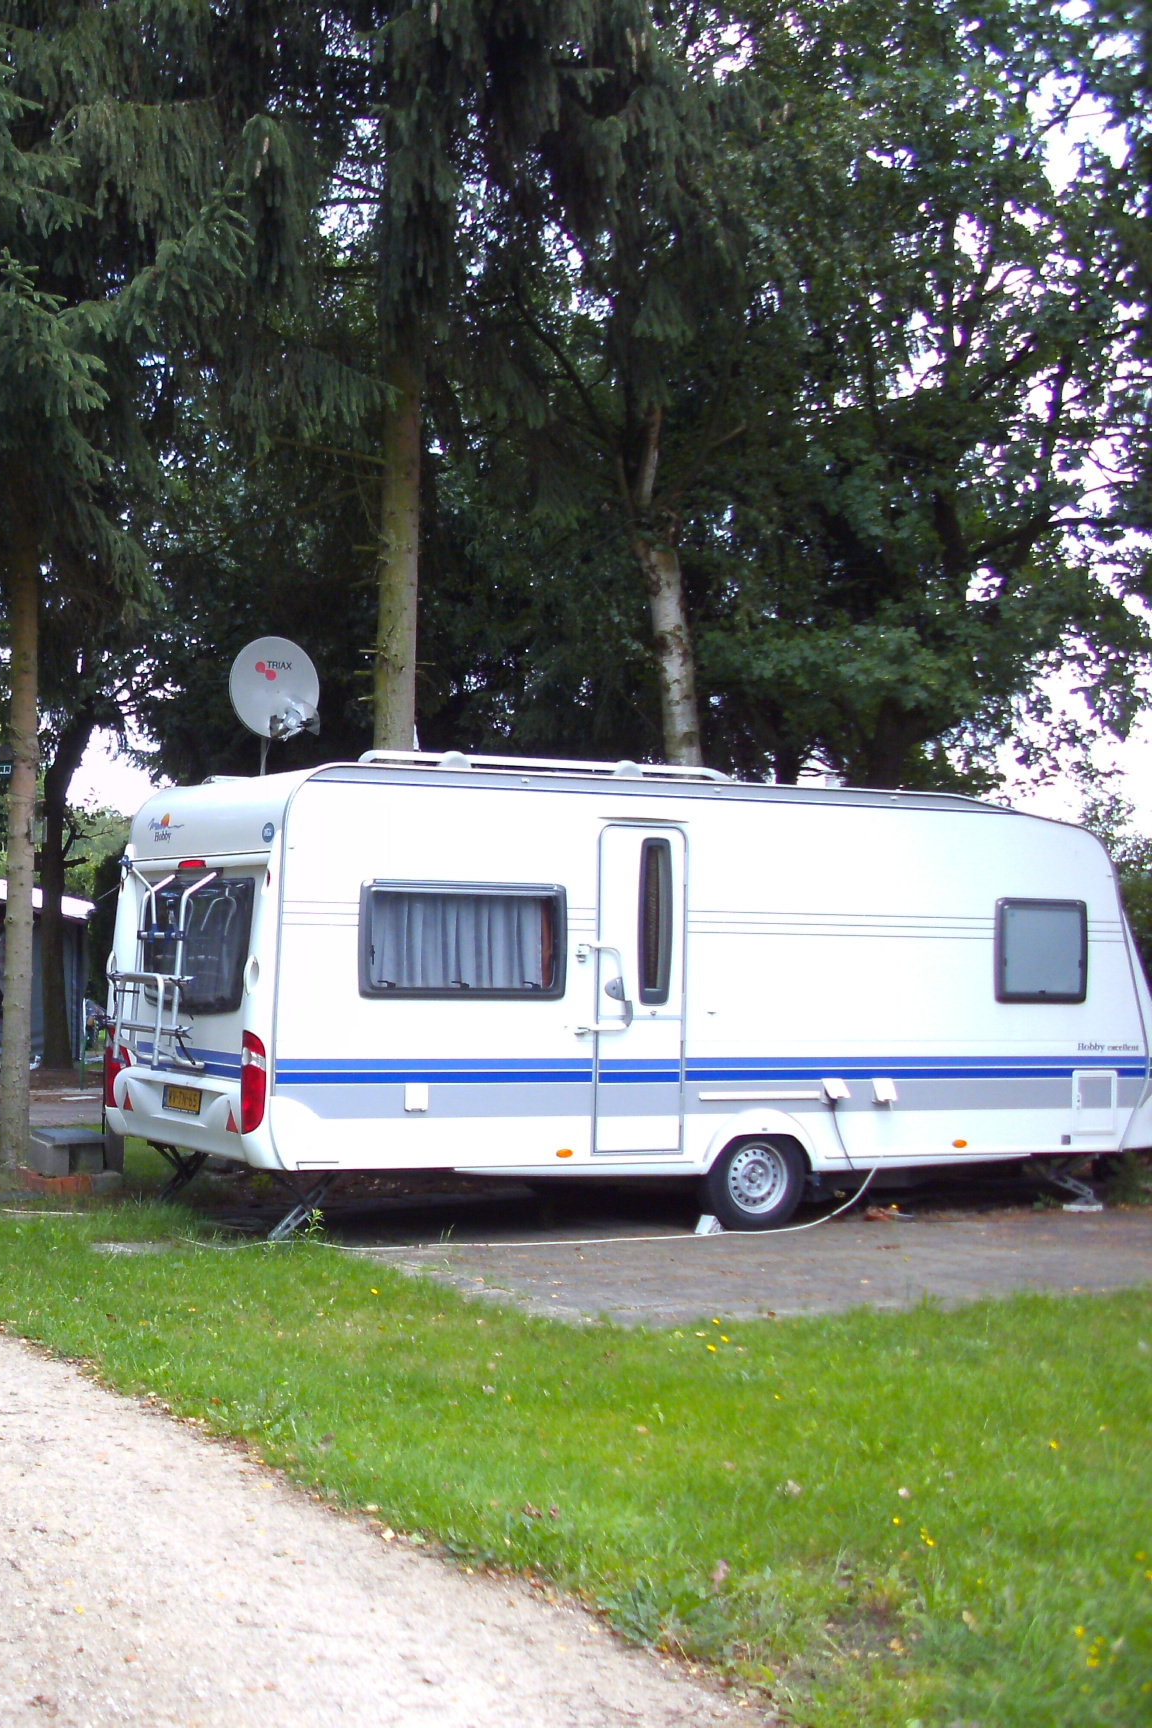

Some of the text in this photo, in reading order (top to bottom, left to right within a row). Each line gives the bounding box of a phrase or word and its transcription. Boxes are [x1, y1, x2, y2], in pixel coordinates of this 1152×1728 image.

[267, 661, 292, 670] TRIAX
[154, 831, 172, 843] Hobby
[1077, 1042, 1105, 1053] Hobby
